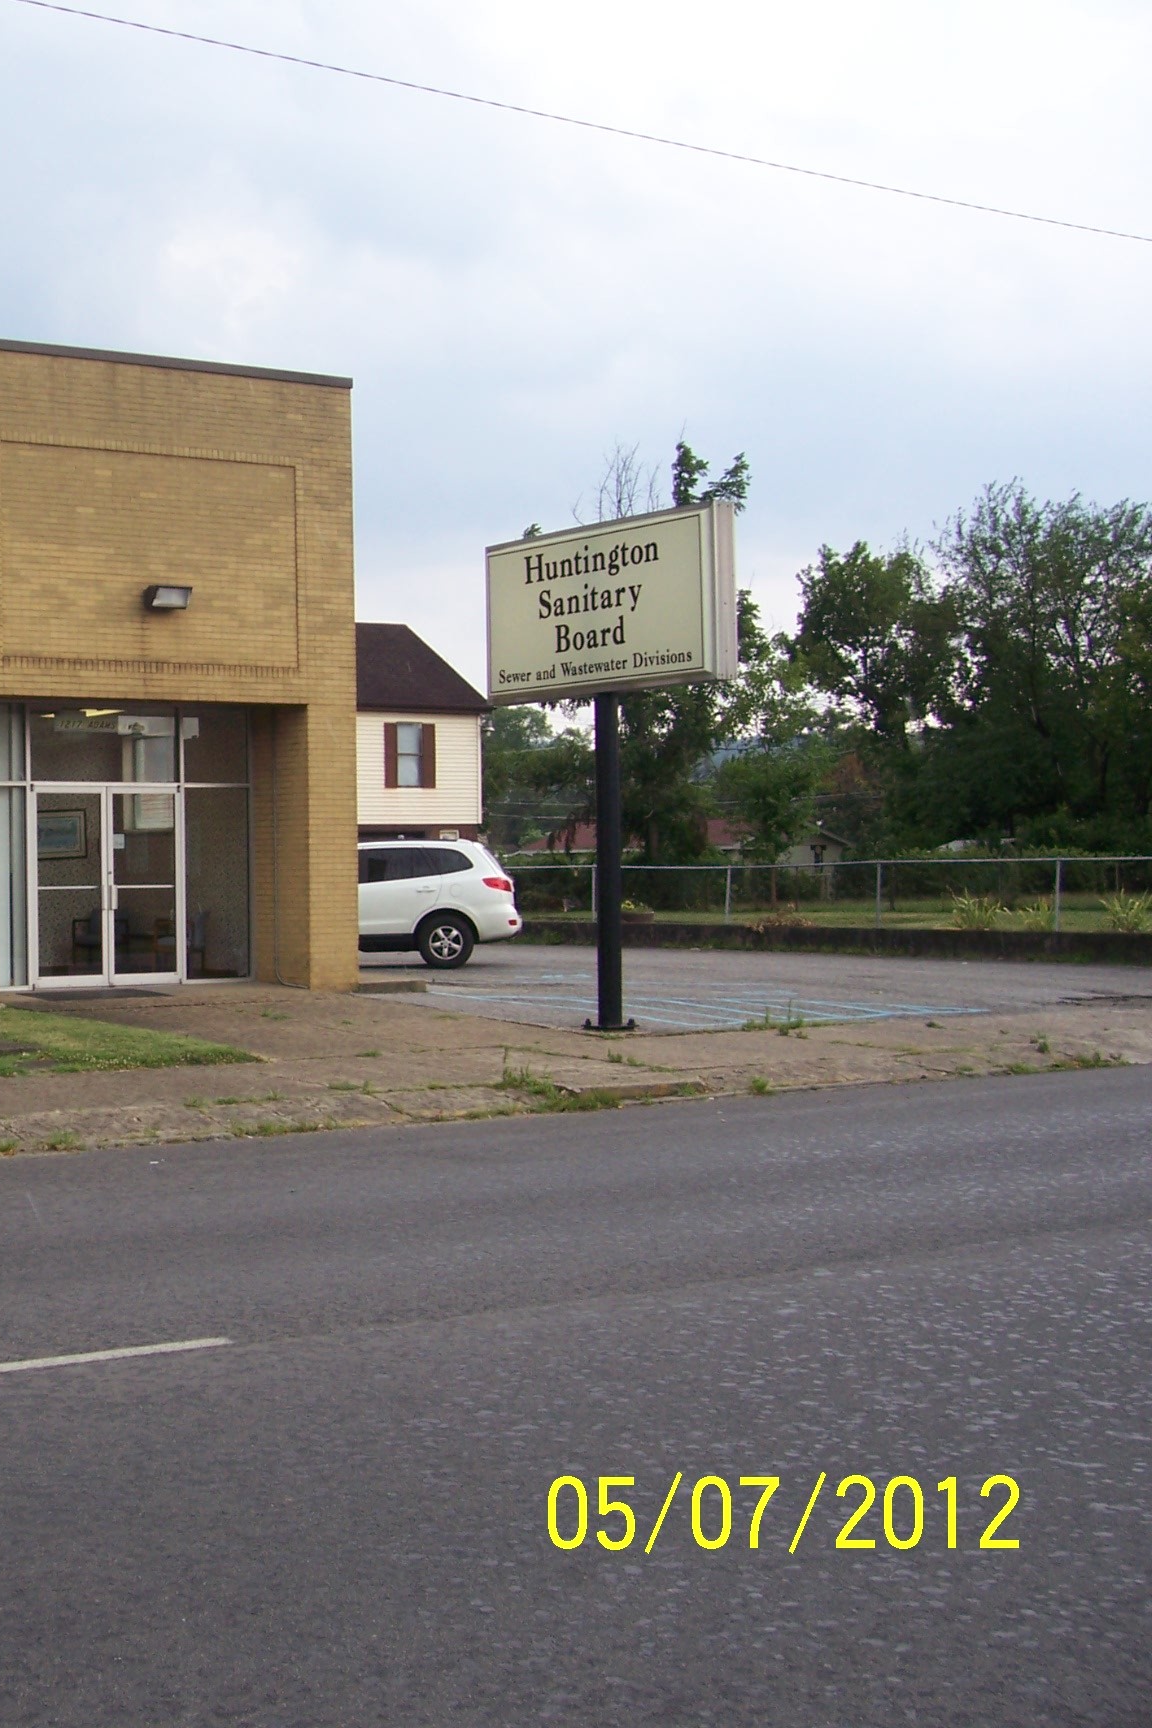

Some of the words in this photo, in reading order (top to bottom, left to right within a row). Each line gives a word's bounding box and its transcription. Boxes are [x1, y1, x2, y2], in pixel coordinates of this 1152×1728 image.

[524, 541, 659, 584] Huntington
[538, 583, 642, 620] Sanitary
[554, 615, 625, 653] Board
[498, 669, 532, 684] Sewer
[535, 664, 556, 680] and
[560, 658, 628, 677] Wastewater
[632, 649, 693, 669] Divisions
